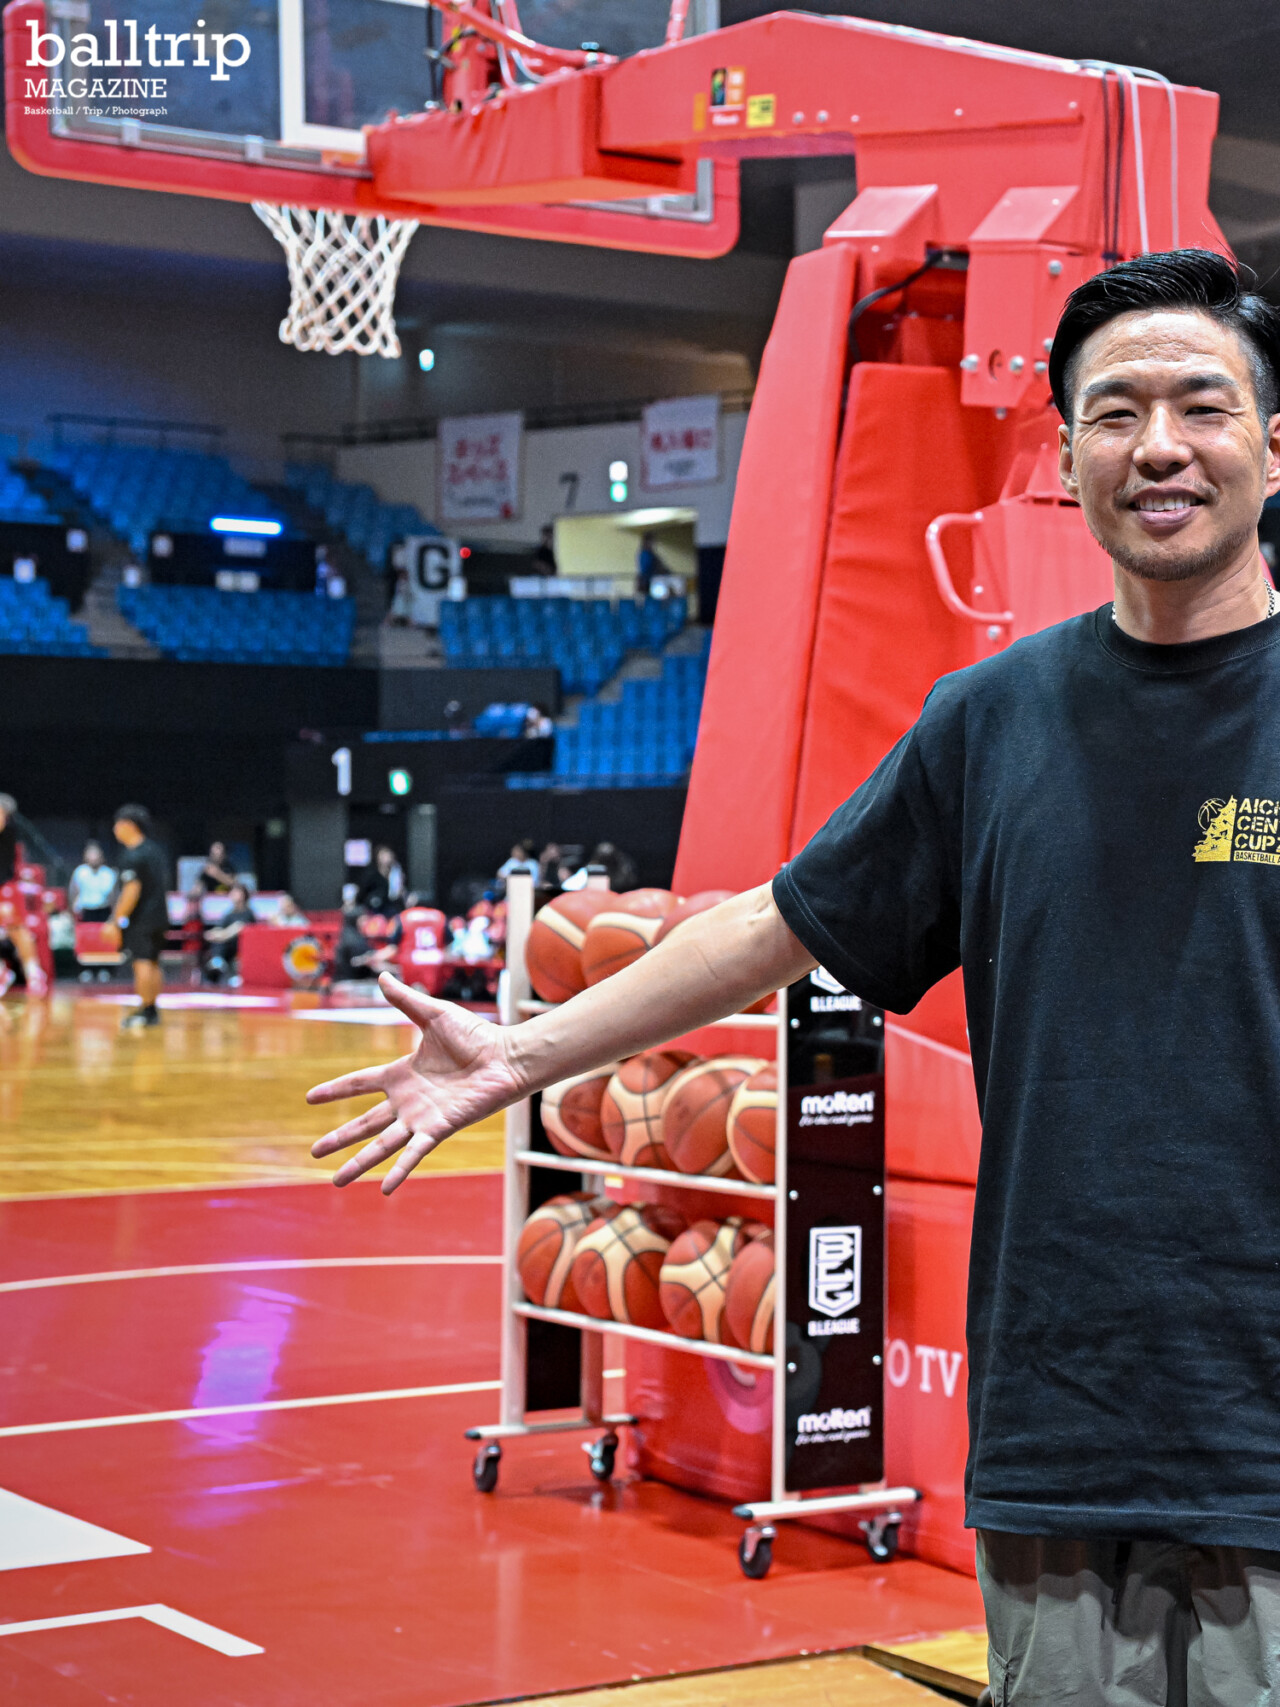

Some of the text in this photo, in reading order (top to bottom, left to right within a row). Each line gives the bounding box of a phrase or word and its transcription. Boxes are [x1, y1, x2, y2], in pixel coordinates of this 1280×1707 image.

[559, 471, 581, 508] 7
[417, 543, 451, 591] G
[331, 747, 352, 795] 1
[1234, 833, 1276, 851] CUP
[1235, 852, 1275, 864] BASKETBALL
[801, 1090, 874, 1114] molten
[915, 1344, 963, 1398] TV
[797, 1407, 871, 1433] molten
